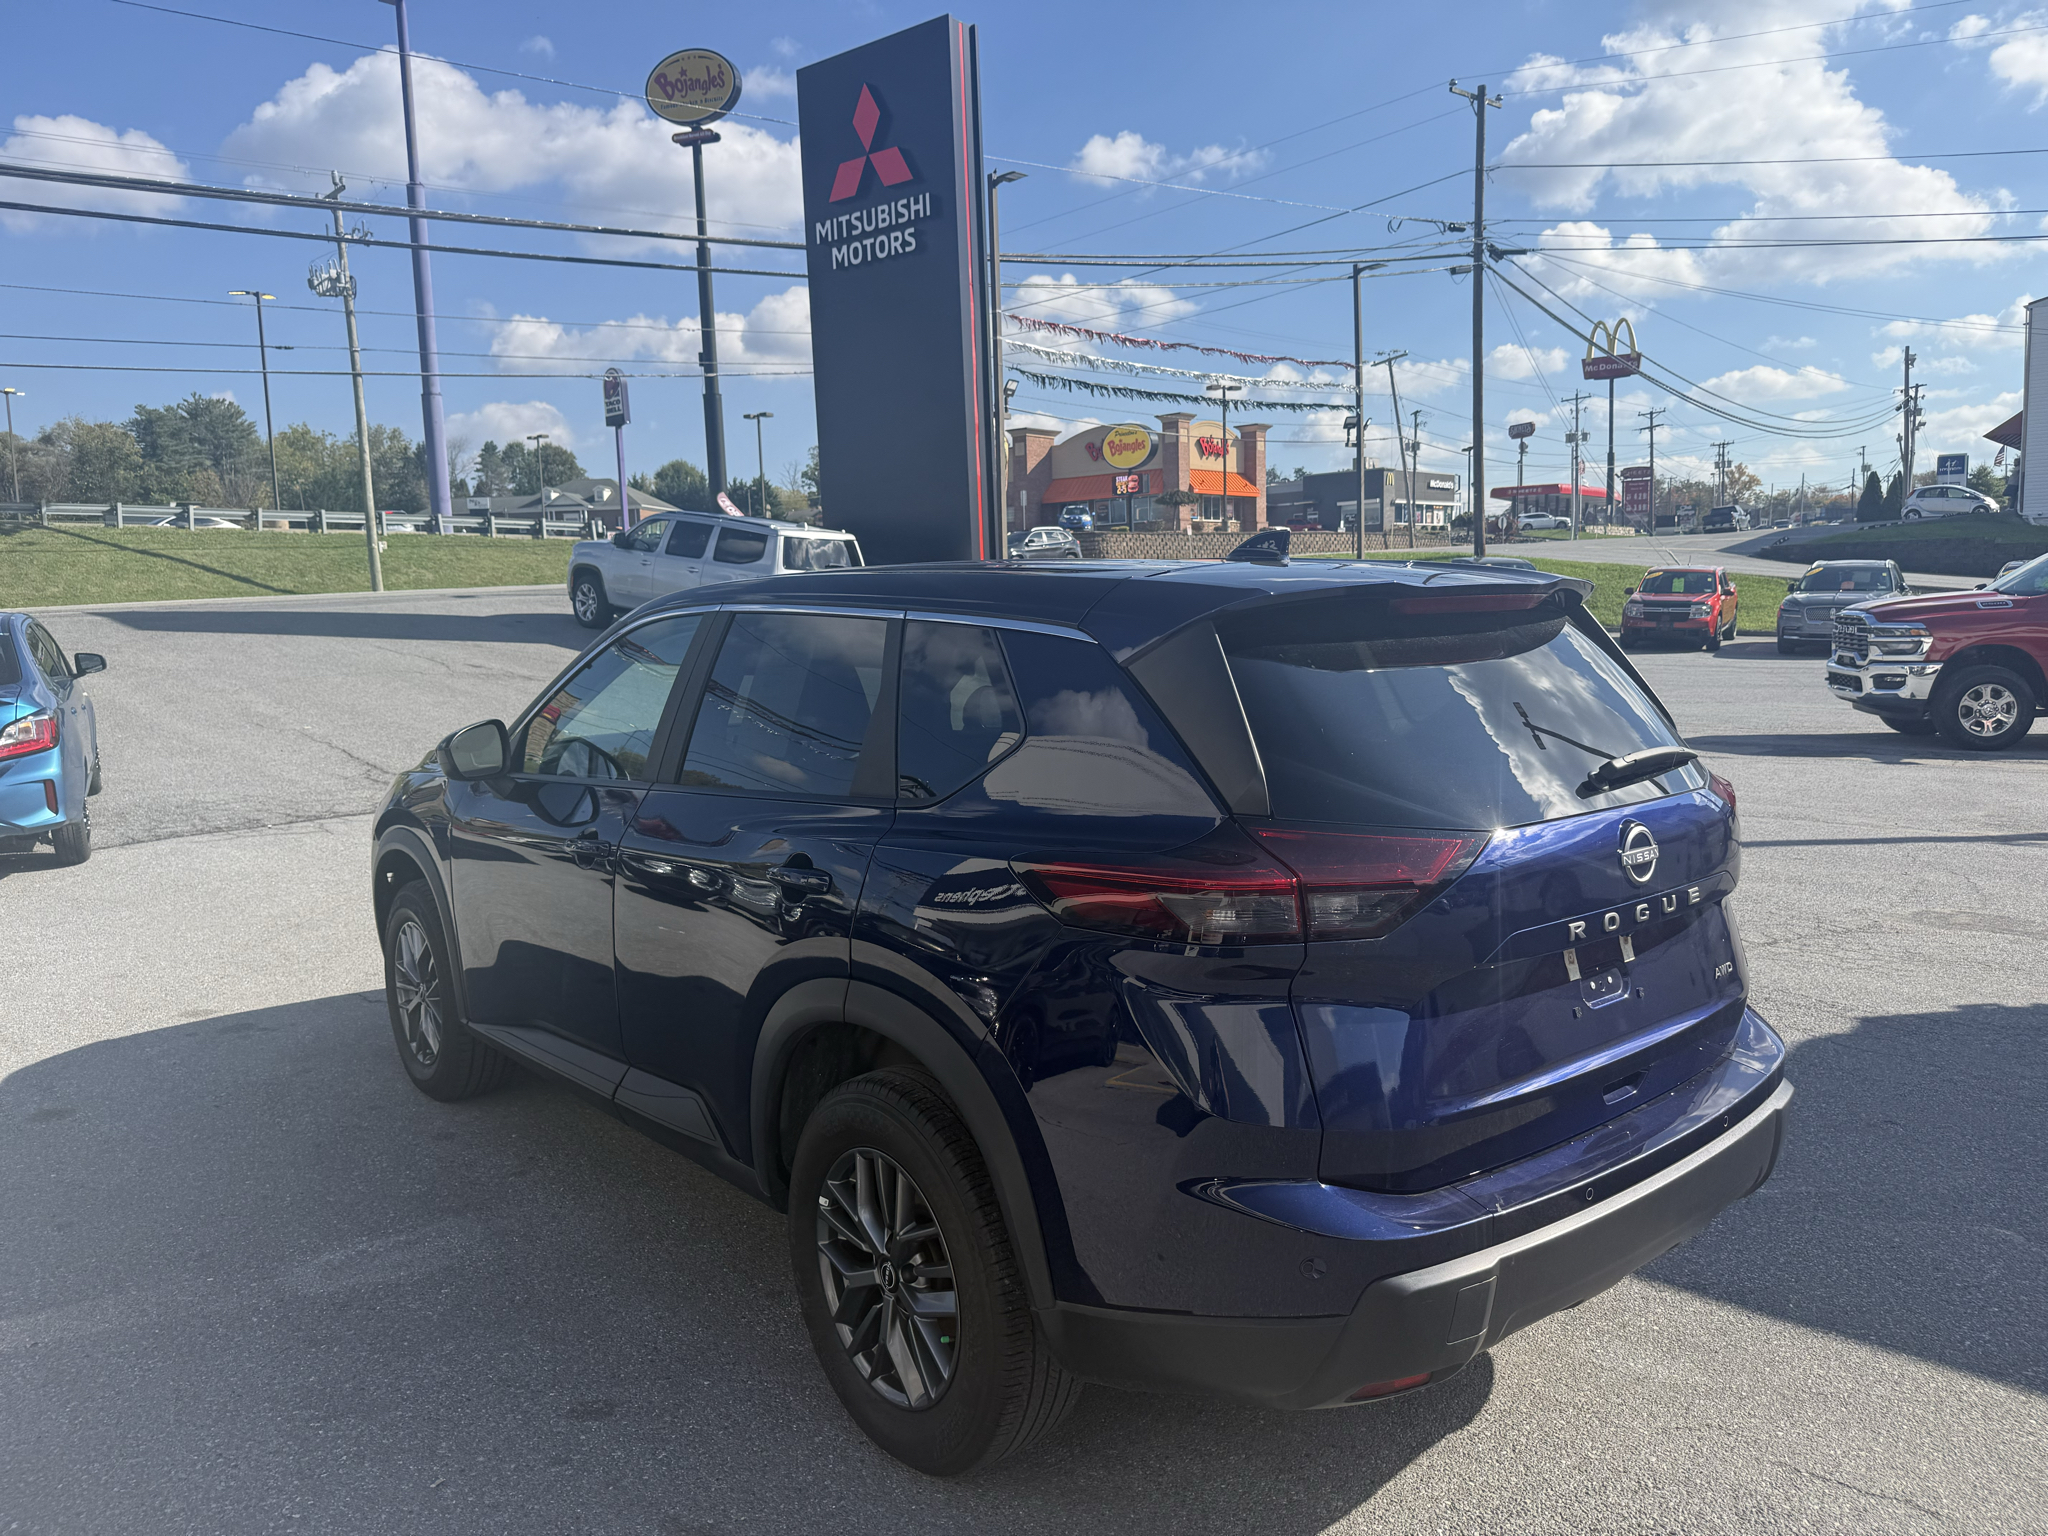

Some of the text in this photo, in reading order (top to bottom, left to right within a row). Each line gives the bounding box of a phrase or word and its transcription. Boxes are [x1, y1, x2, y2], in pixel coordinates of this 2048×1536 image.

[815, 192, 931, 245] MITSUBISHI
[831, 227, 917, 270] MOTORS
[1107, 438, 1146, 457] Bojangles
[1622, 845, 1659, 865] NISSAN
[1568, 886, 1701, 942] ROGUE
[1715, 961, 1734, 980] AWD
